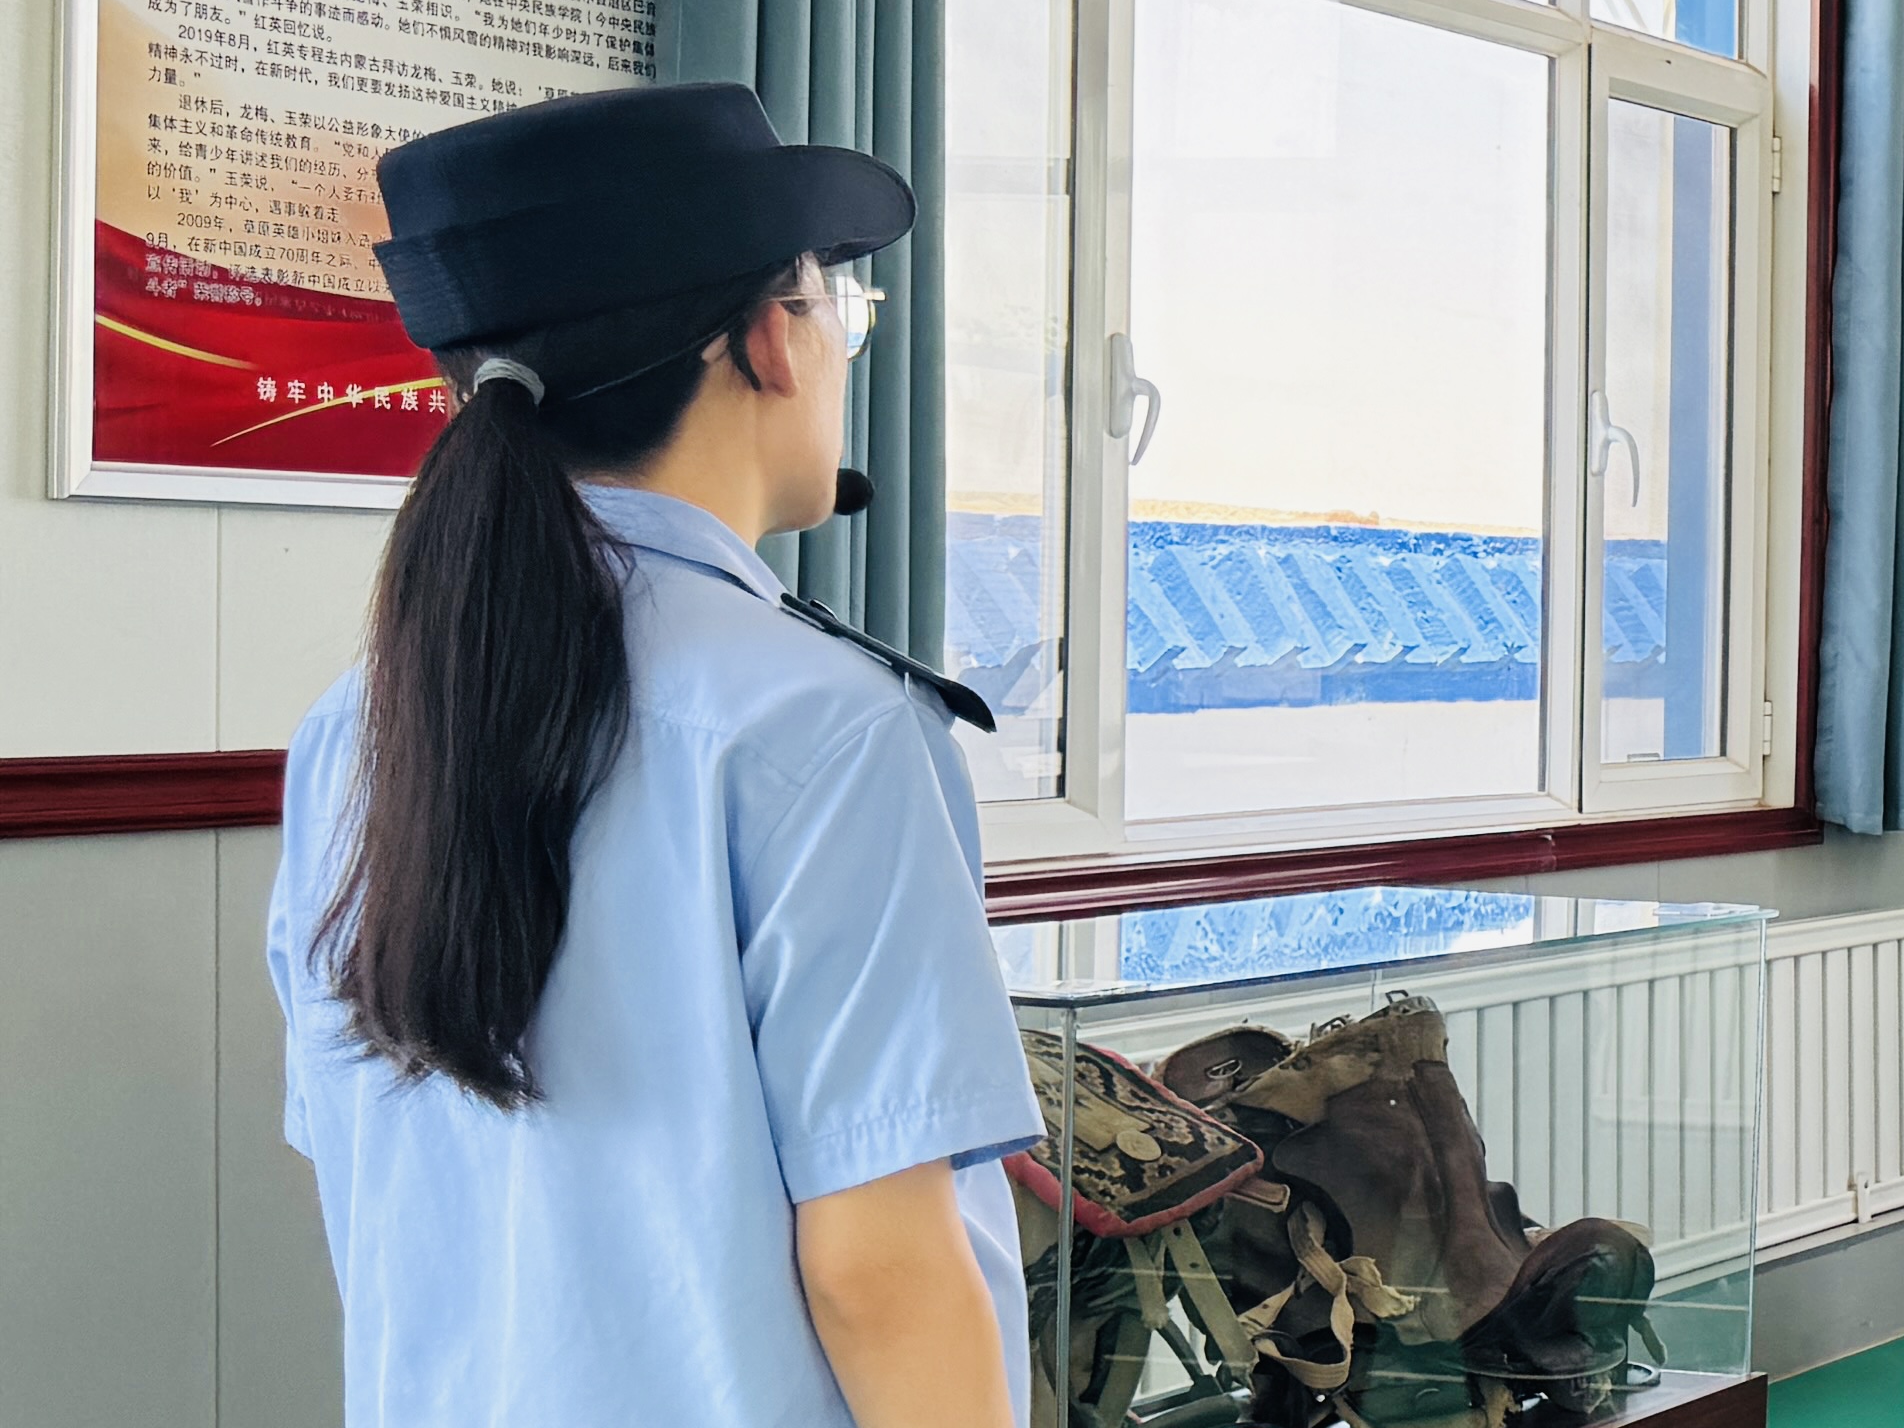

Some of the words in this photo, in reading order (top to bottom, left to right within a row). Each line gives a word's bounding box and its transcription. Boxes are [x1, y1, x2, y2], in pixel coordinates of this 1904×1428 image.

[257, 376, 447, 414] 铸牢中华民族共
